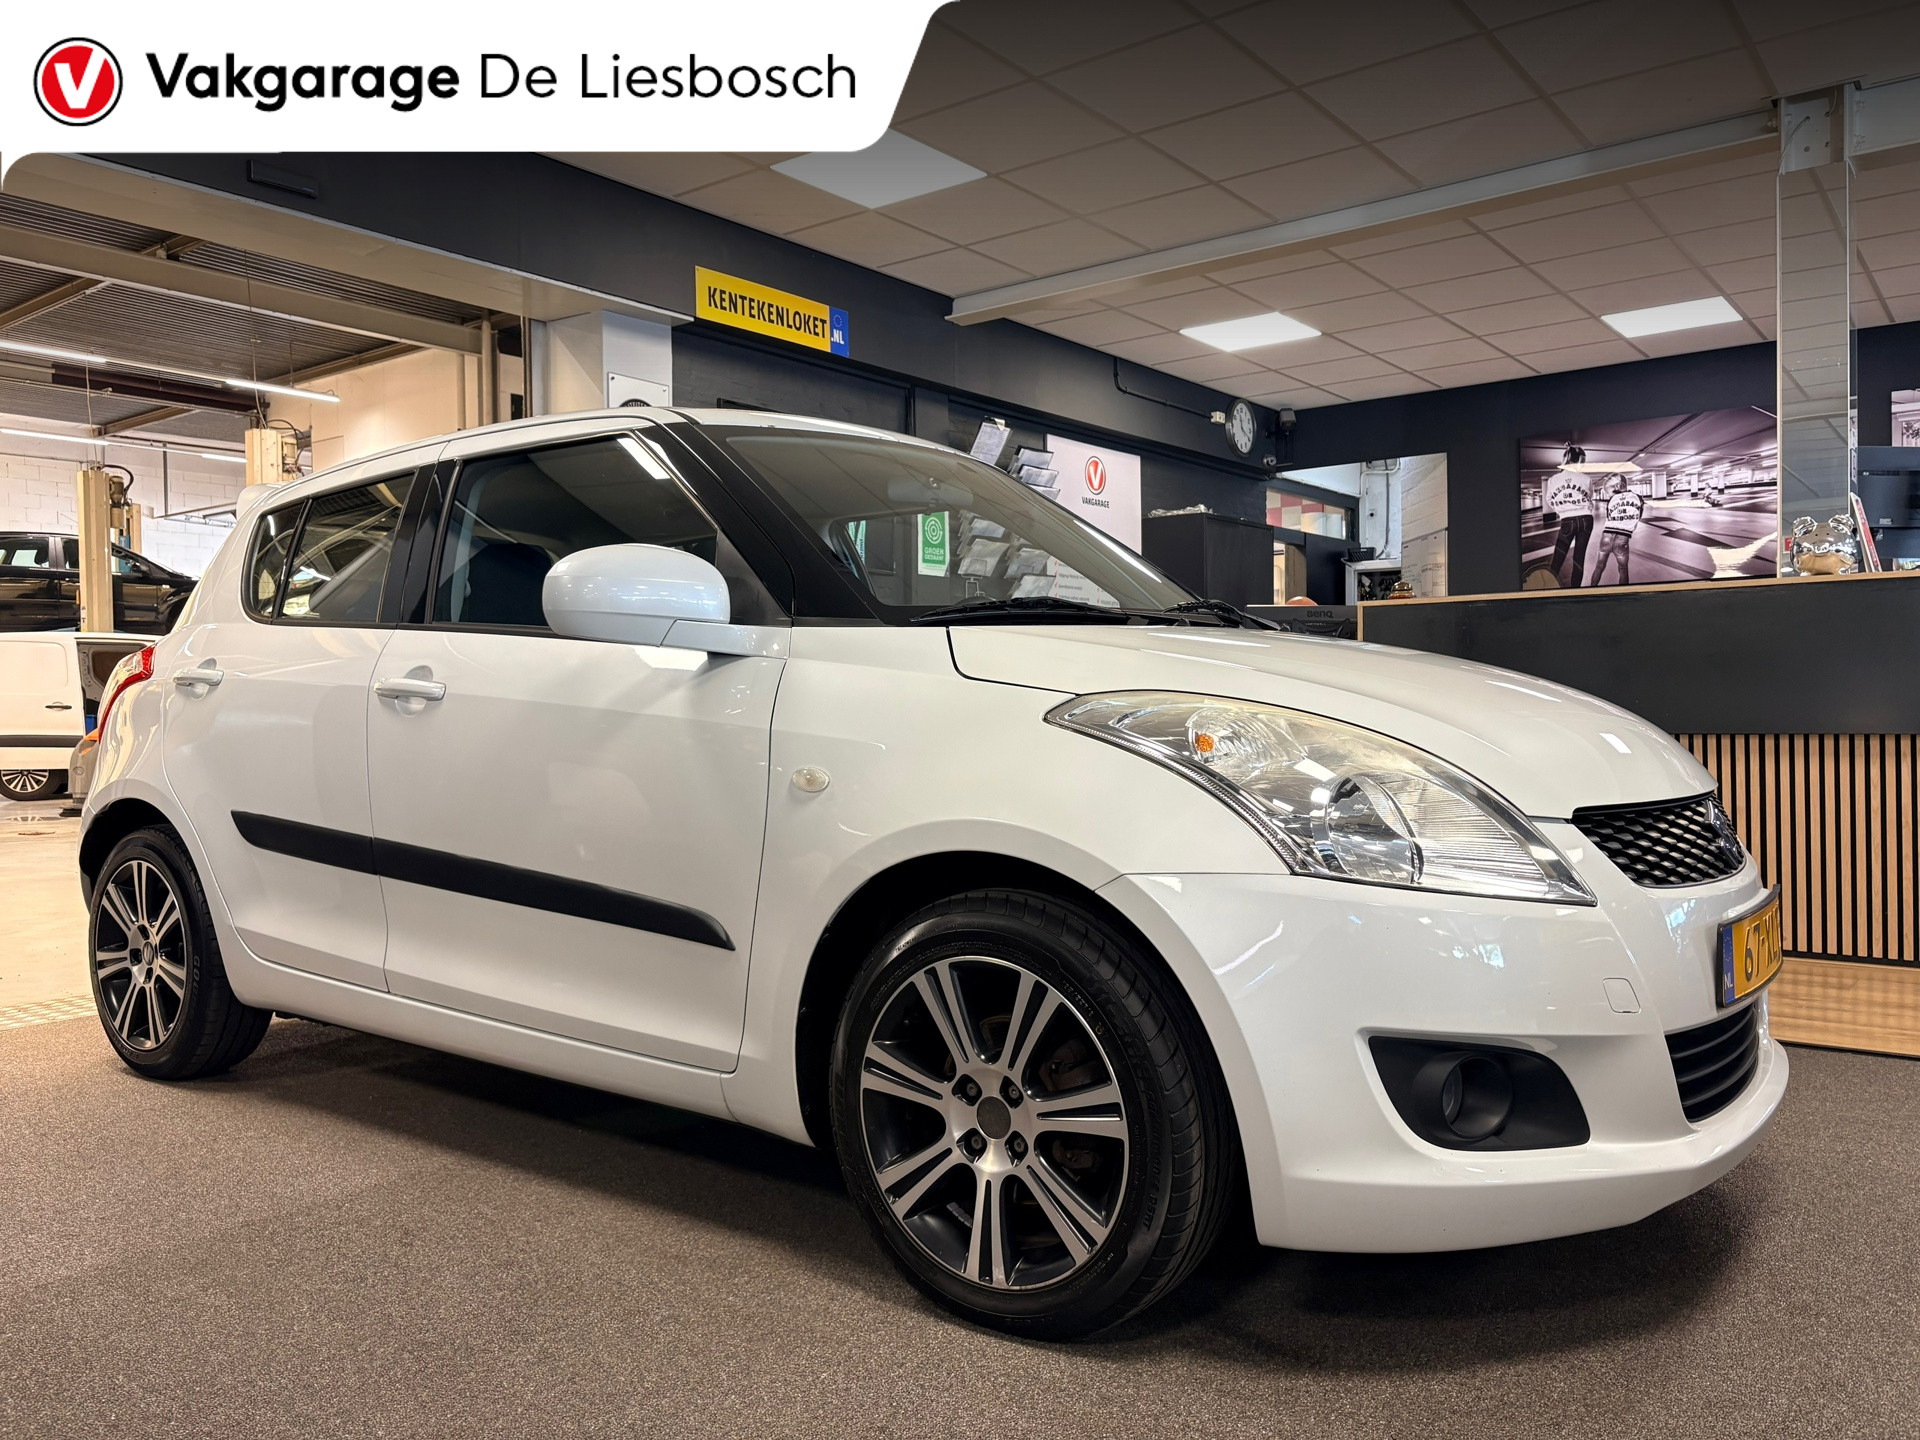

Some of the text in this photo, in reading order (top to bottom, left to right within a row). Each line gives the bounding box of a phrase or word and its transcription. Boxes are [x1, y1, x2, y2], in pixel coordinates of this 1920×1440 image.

[708, 285, 827, 338] KENTEKENLOKET
[1081, 496, 1110, 509] VAKGARAGE
[924, 547, 944, 556] GROEN
[1724, 972, 1733, 989] NL
